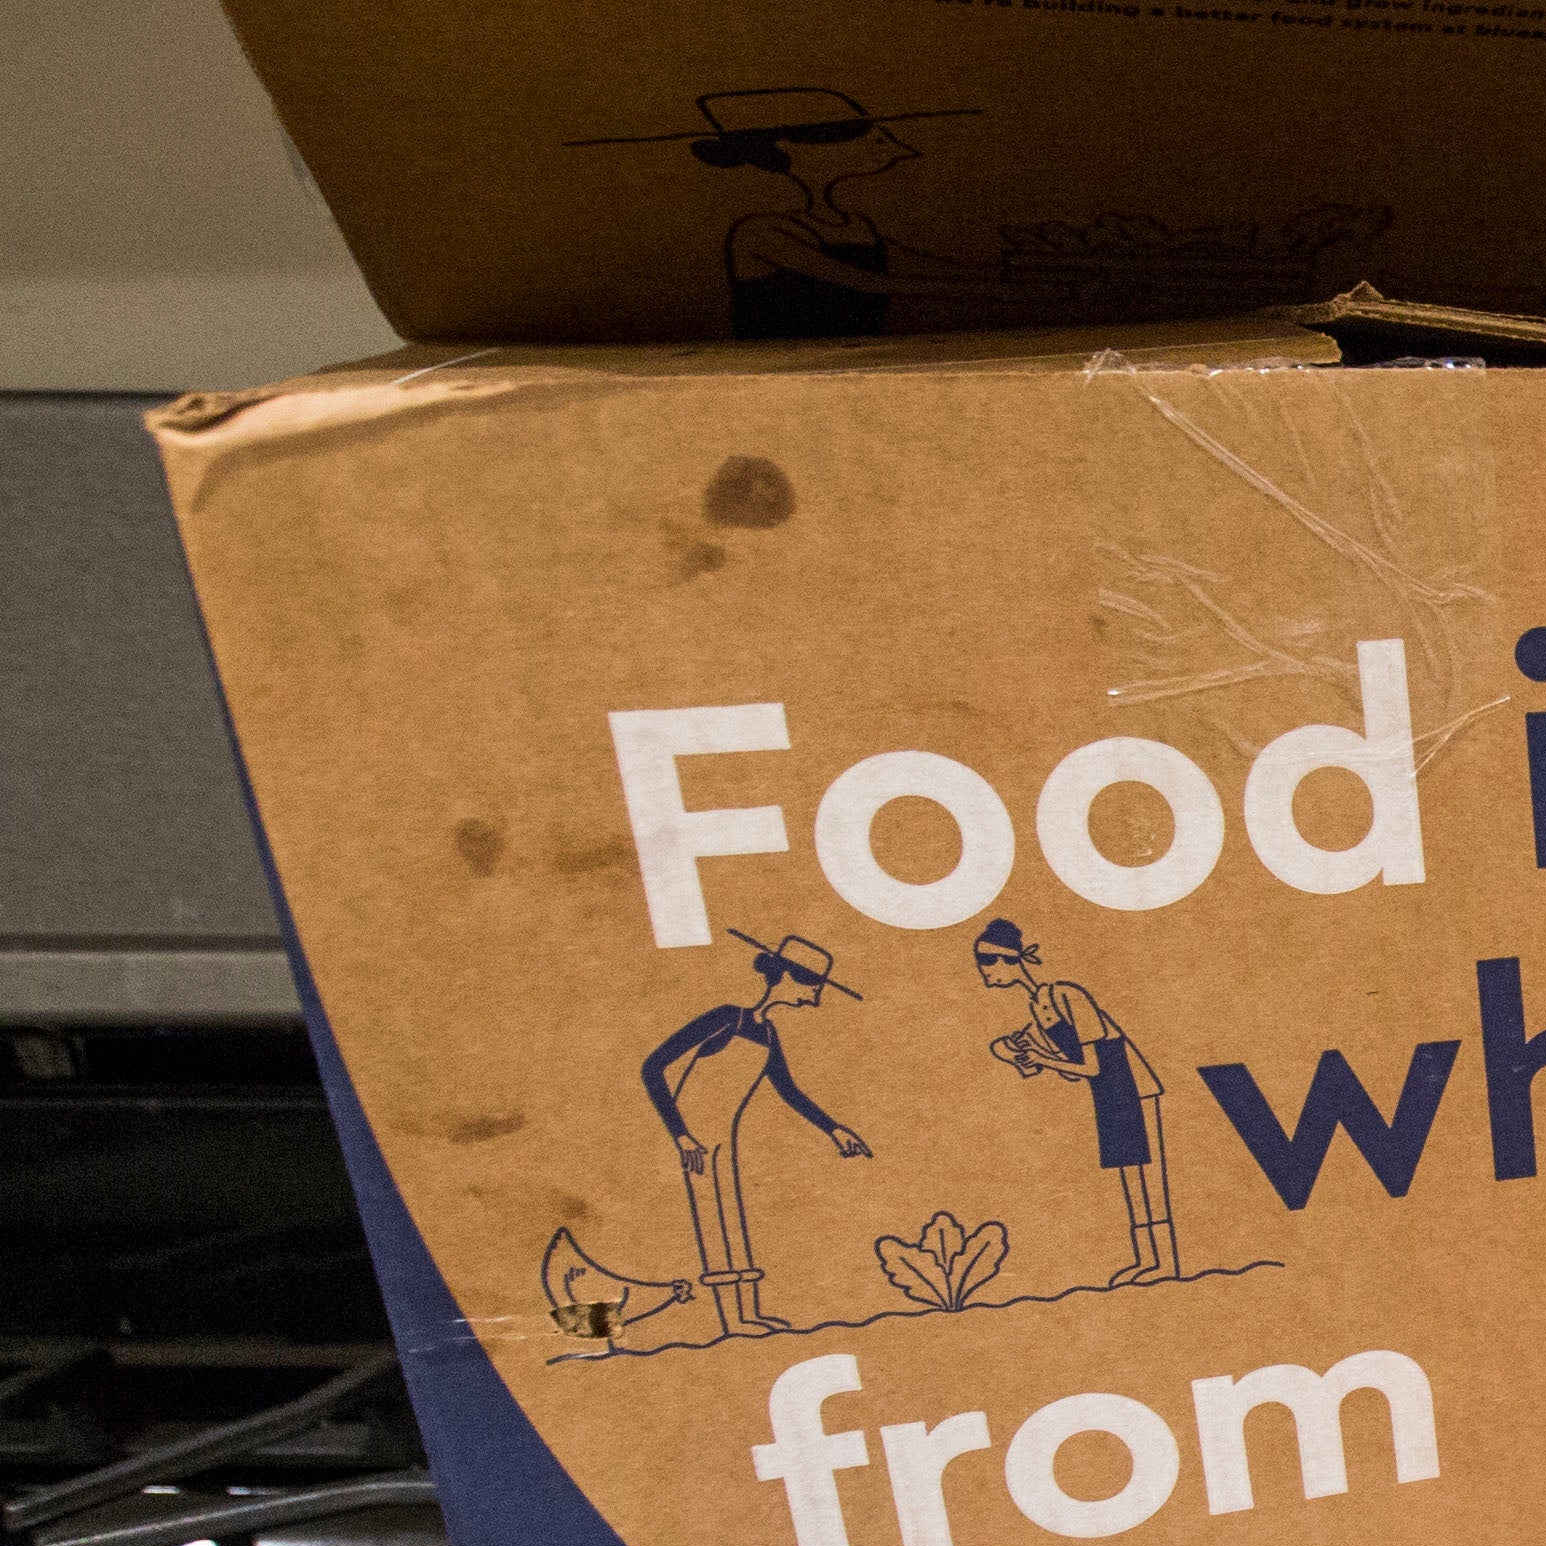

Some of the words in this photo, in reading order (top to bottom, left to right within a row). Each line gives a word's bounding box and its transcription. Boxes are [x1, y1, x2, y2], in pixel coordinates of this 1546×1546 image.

[1271, 9, 1332, 27] food
[1340, 15, 1432, 36] system
[609, 638, 1428, 949] Food
